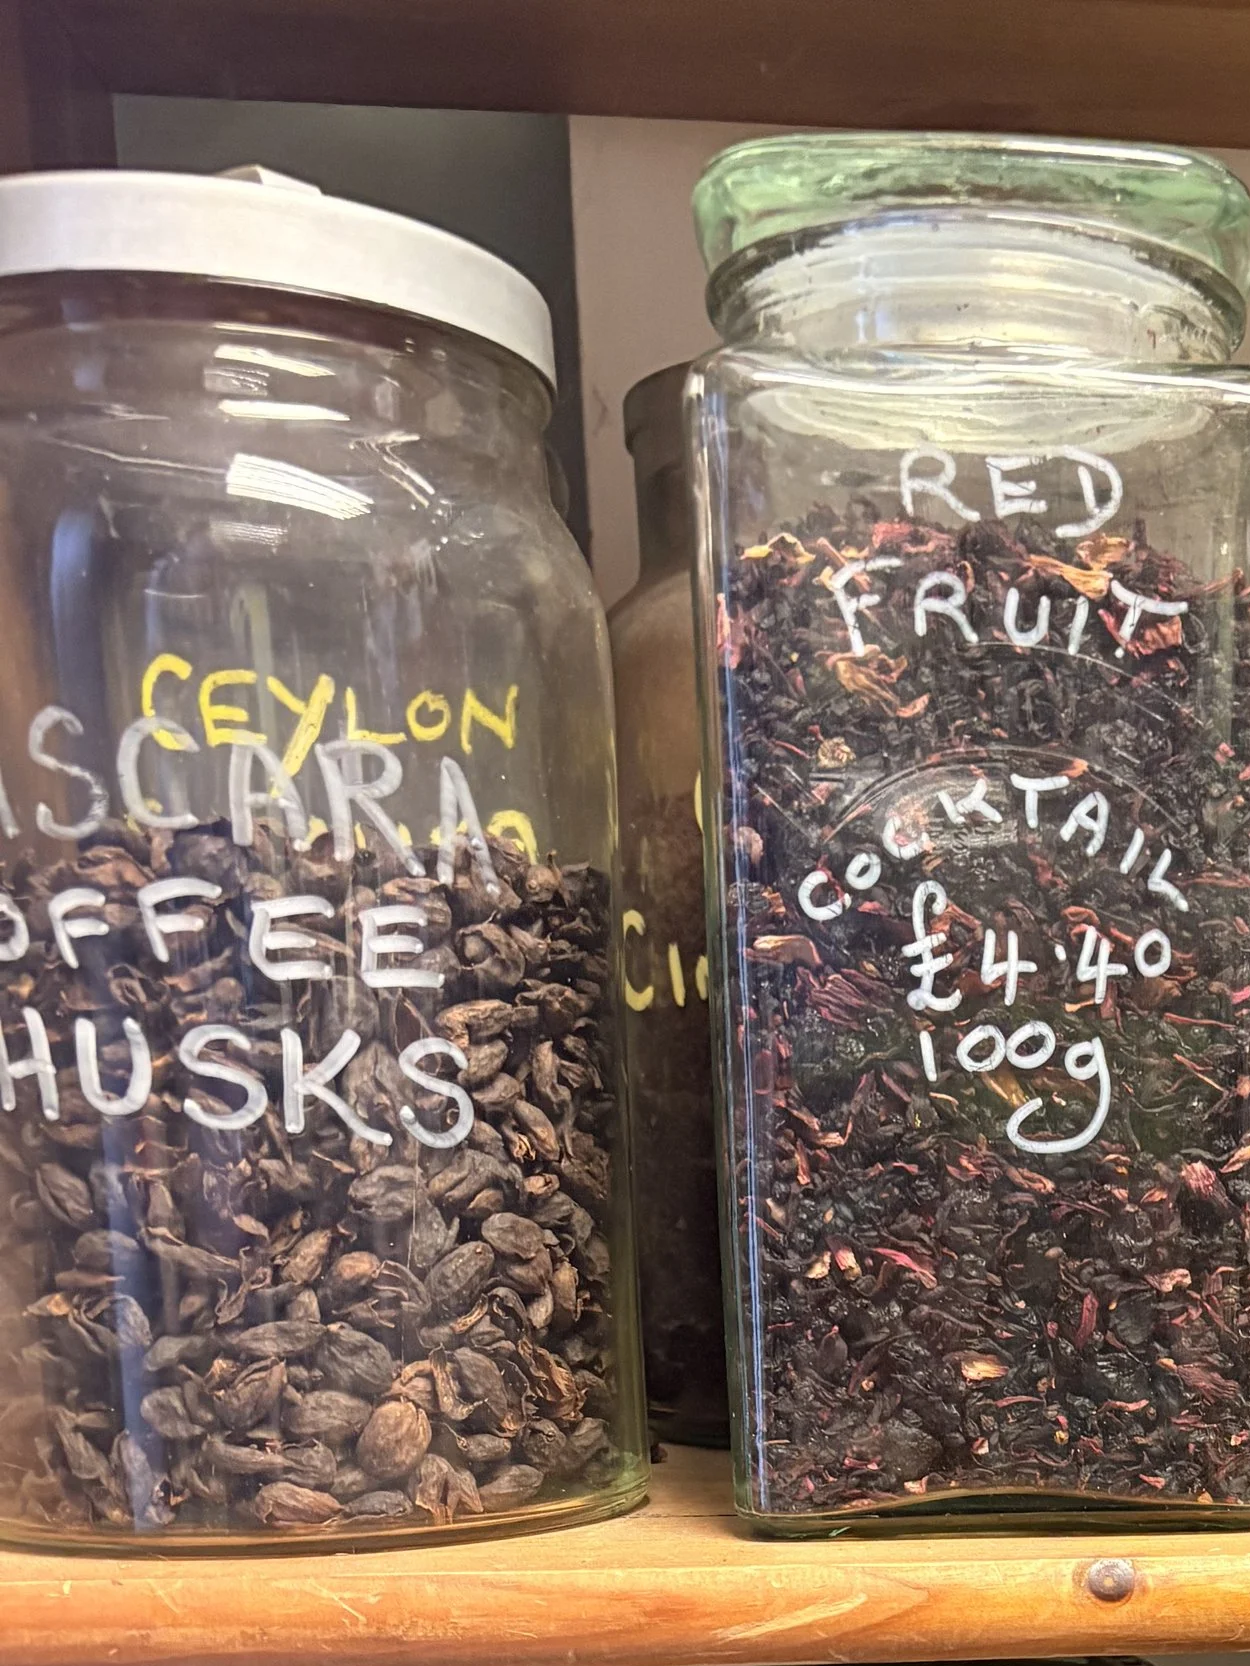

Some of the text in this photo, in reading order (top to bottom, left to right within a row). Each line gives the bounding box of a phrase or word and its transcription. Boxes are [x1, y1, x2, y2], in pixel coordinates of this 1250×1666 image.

[900, 445, 1123, 537] RED
[827, 555, 1188, 658] FRUIT
[141, 652, 519, 797] CEYLON
[0, 705, 501, 897] SCARA
[799, 773, 1188, 920] COCKTAIL
[0, 1007, 474, 1149] HUSKS
[920, 1021, 1112, 1154] 100g
